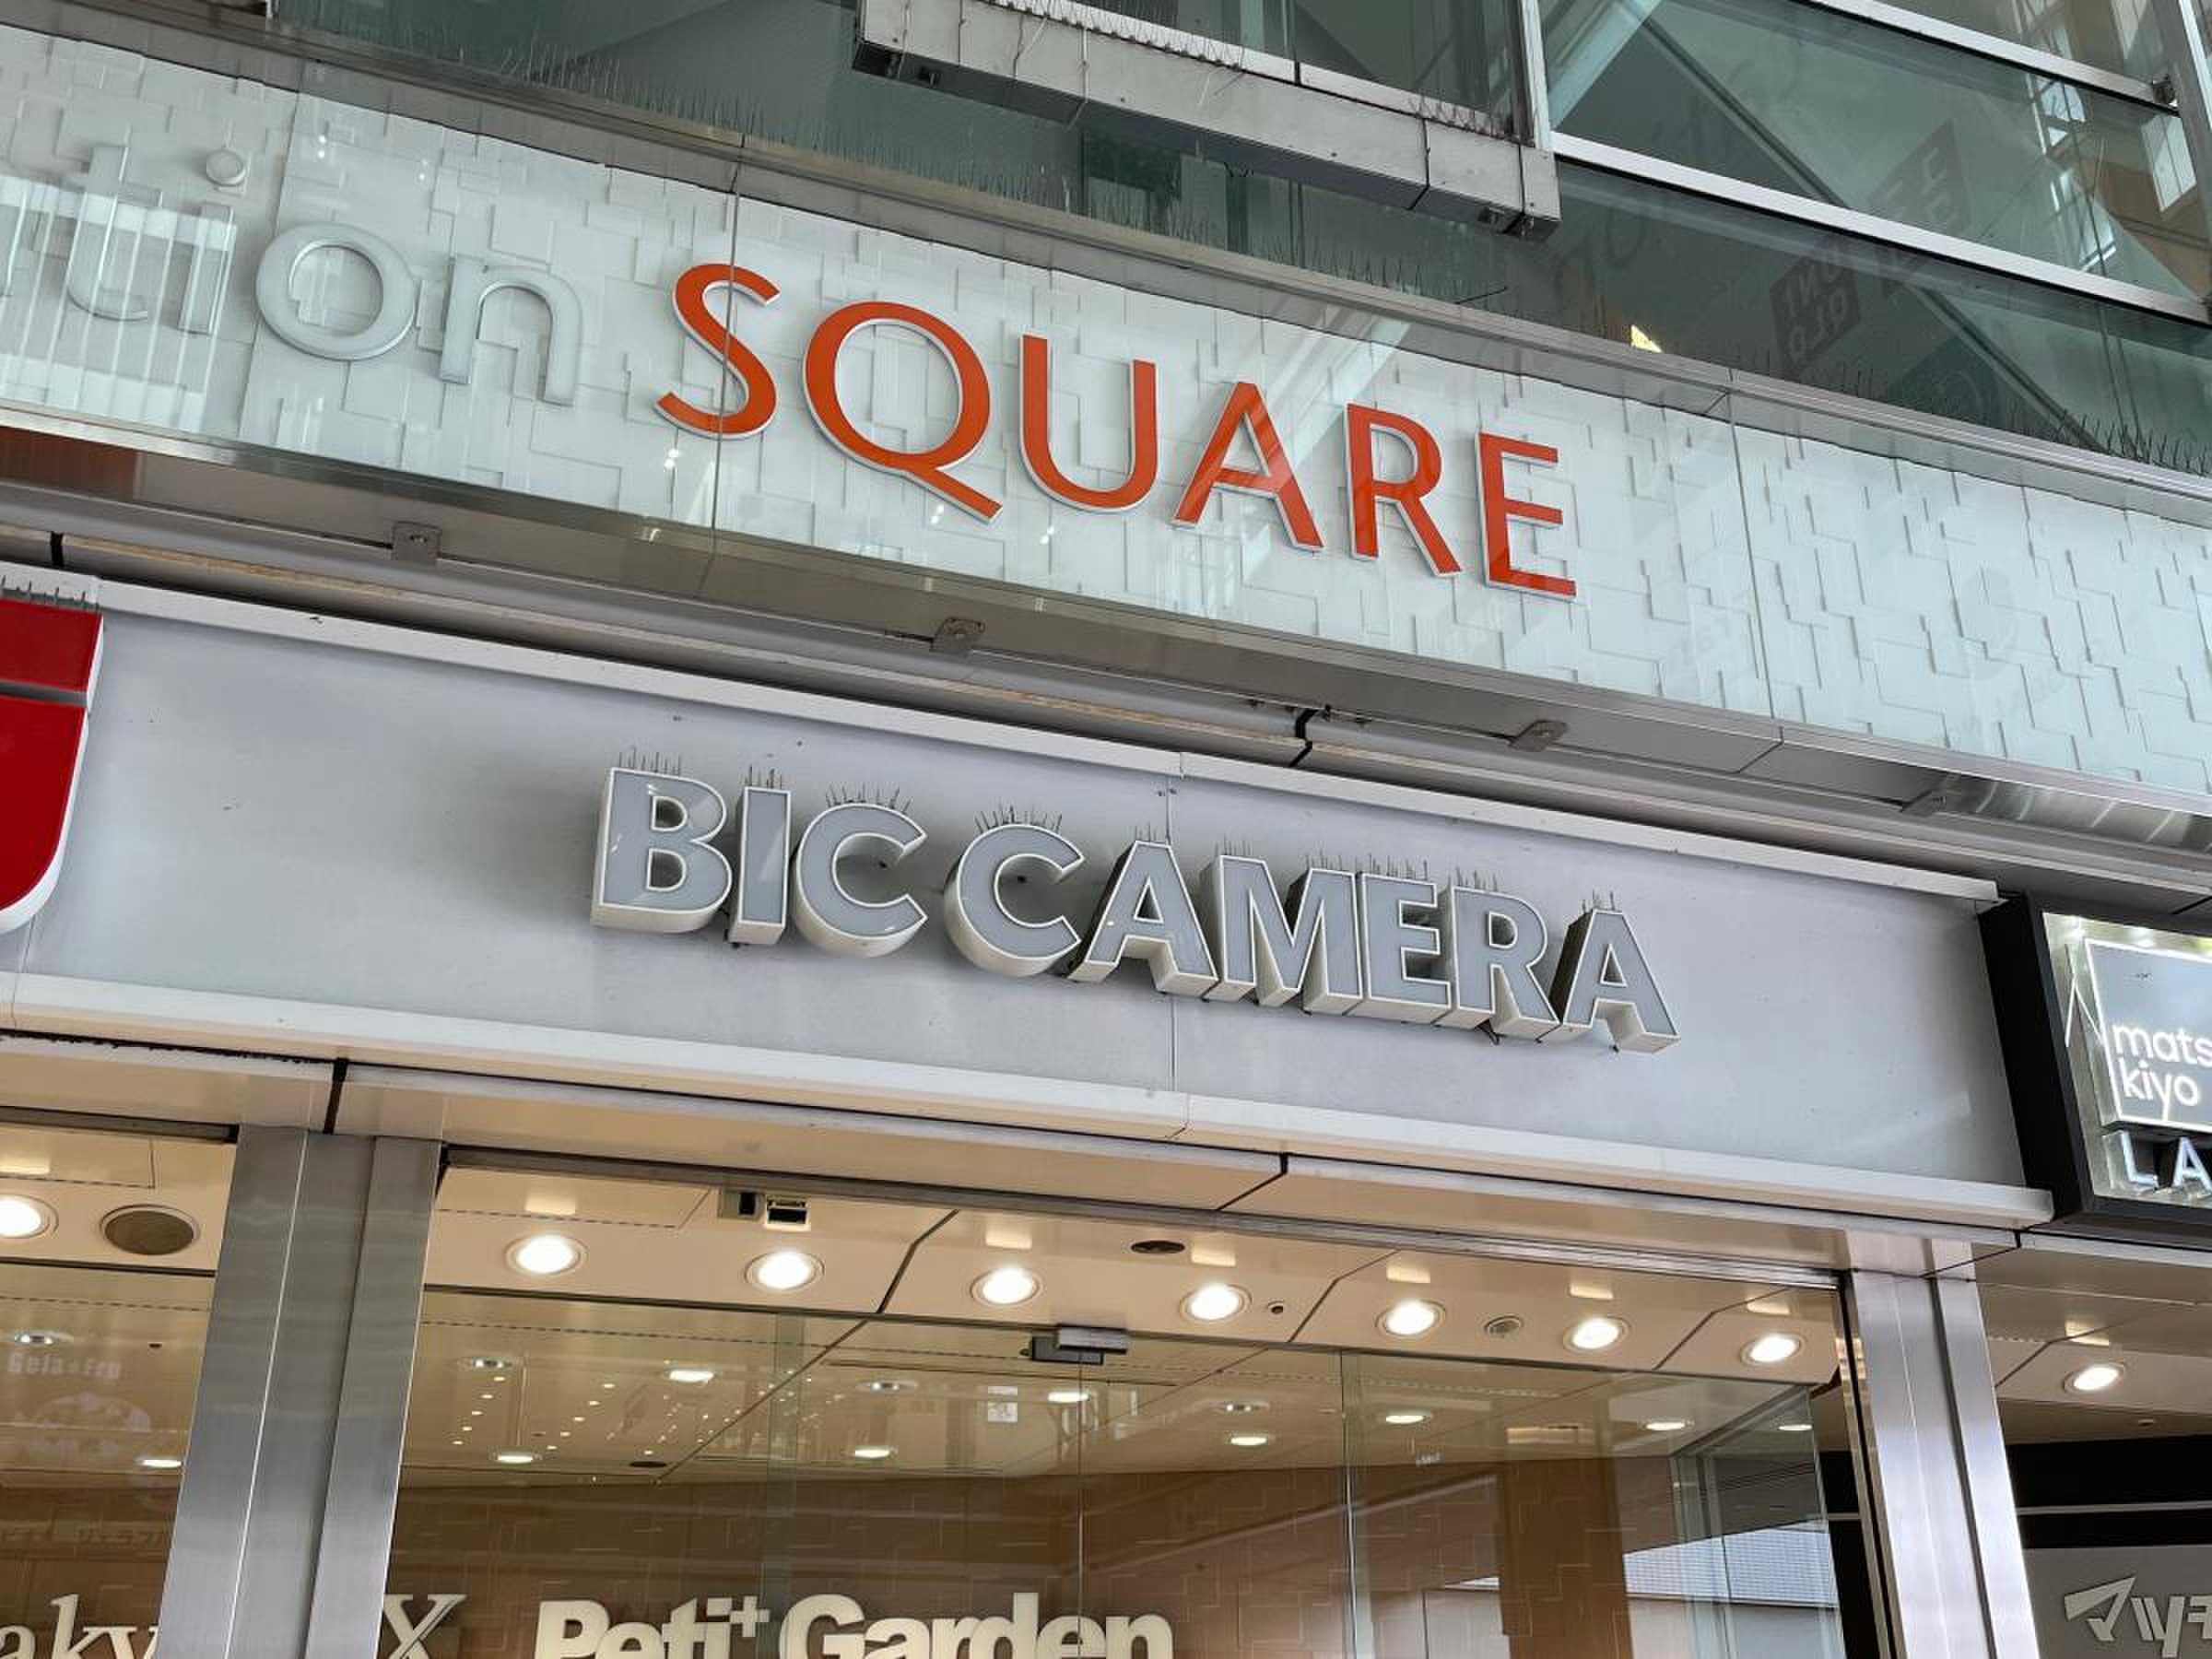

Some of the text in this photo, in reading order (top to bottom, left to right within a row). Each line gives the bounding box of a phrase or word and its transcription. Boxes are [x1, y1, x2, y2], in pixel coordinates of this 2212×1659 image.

[0, 143, 1578, 599] tion SQUARE
[592, 767, 1680, 1053] BIC CAMERA
[2117, 1056, 2202, 1121] kiyo
[2120, 1130, 2212, 1192] LA
